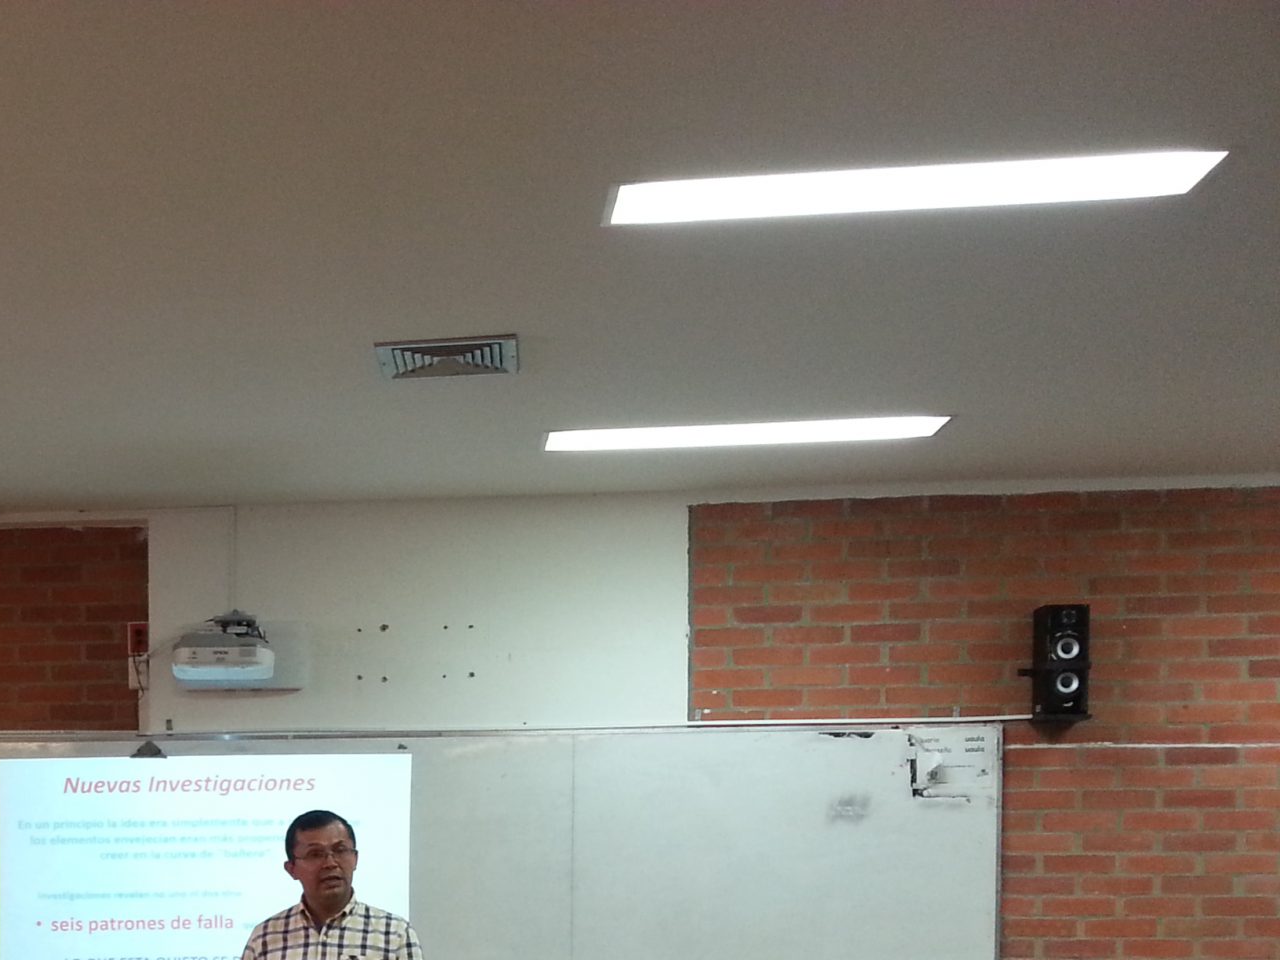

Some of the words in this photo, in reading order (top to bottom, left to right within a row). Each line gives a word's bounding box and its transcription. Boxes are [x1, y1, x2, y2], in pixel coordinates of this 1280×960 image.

[63, 776, 141, 793] Nuevas
[148, 774, 316, 795] Investigaciones
[51, 917, 83, 932] seis
[89, 917, 165, 934] patrones
[171, 915, 193, 930] de
[197, 914, 234, 930] falla
